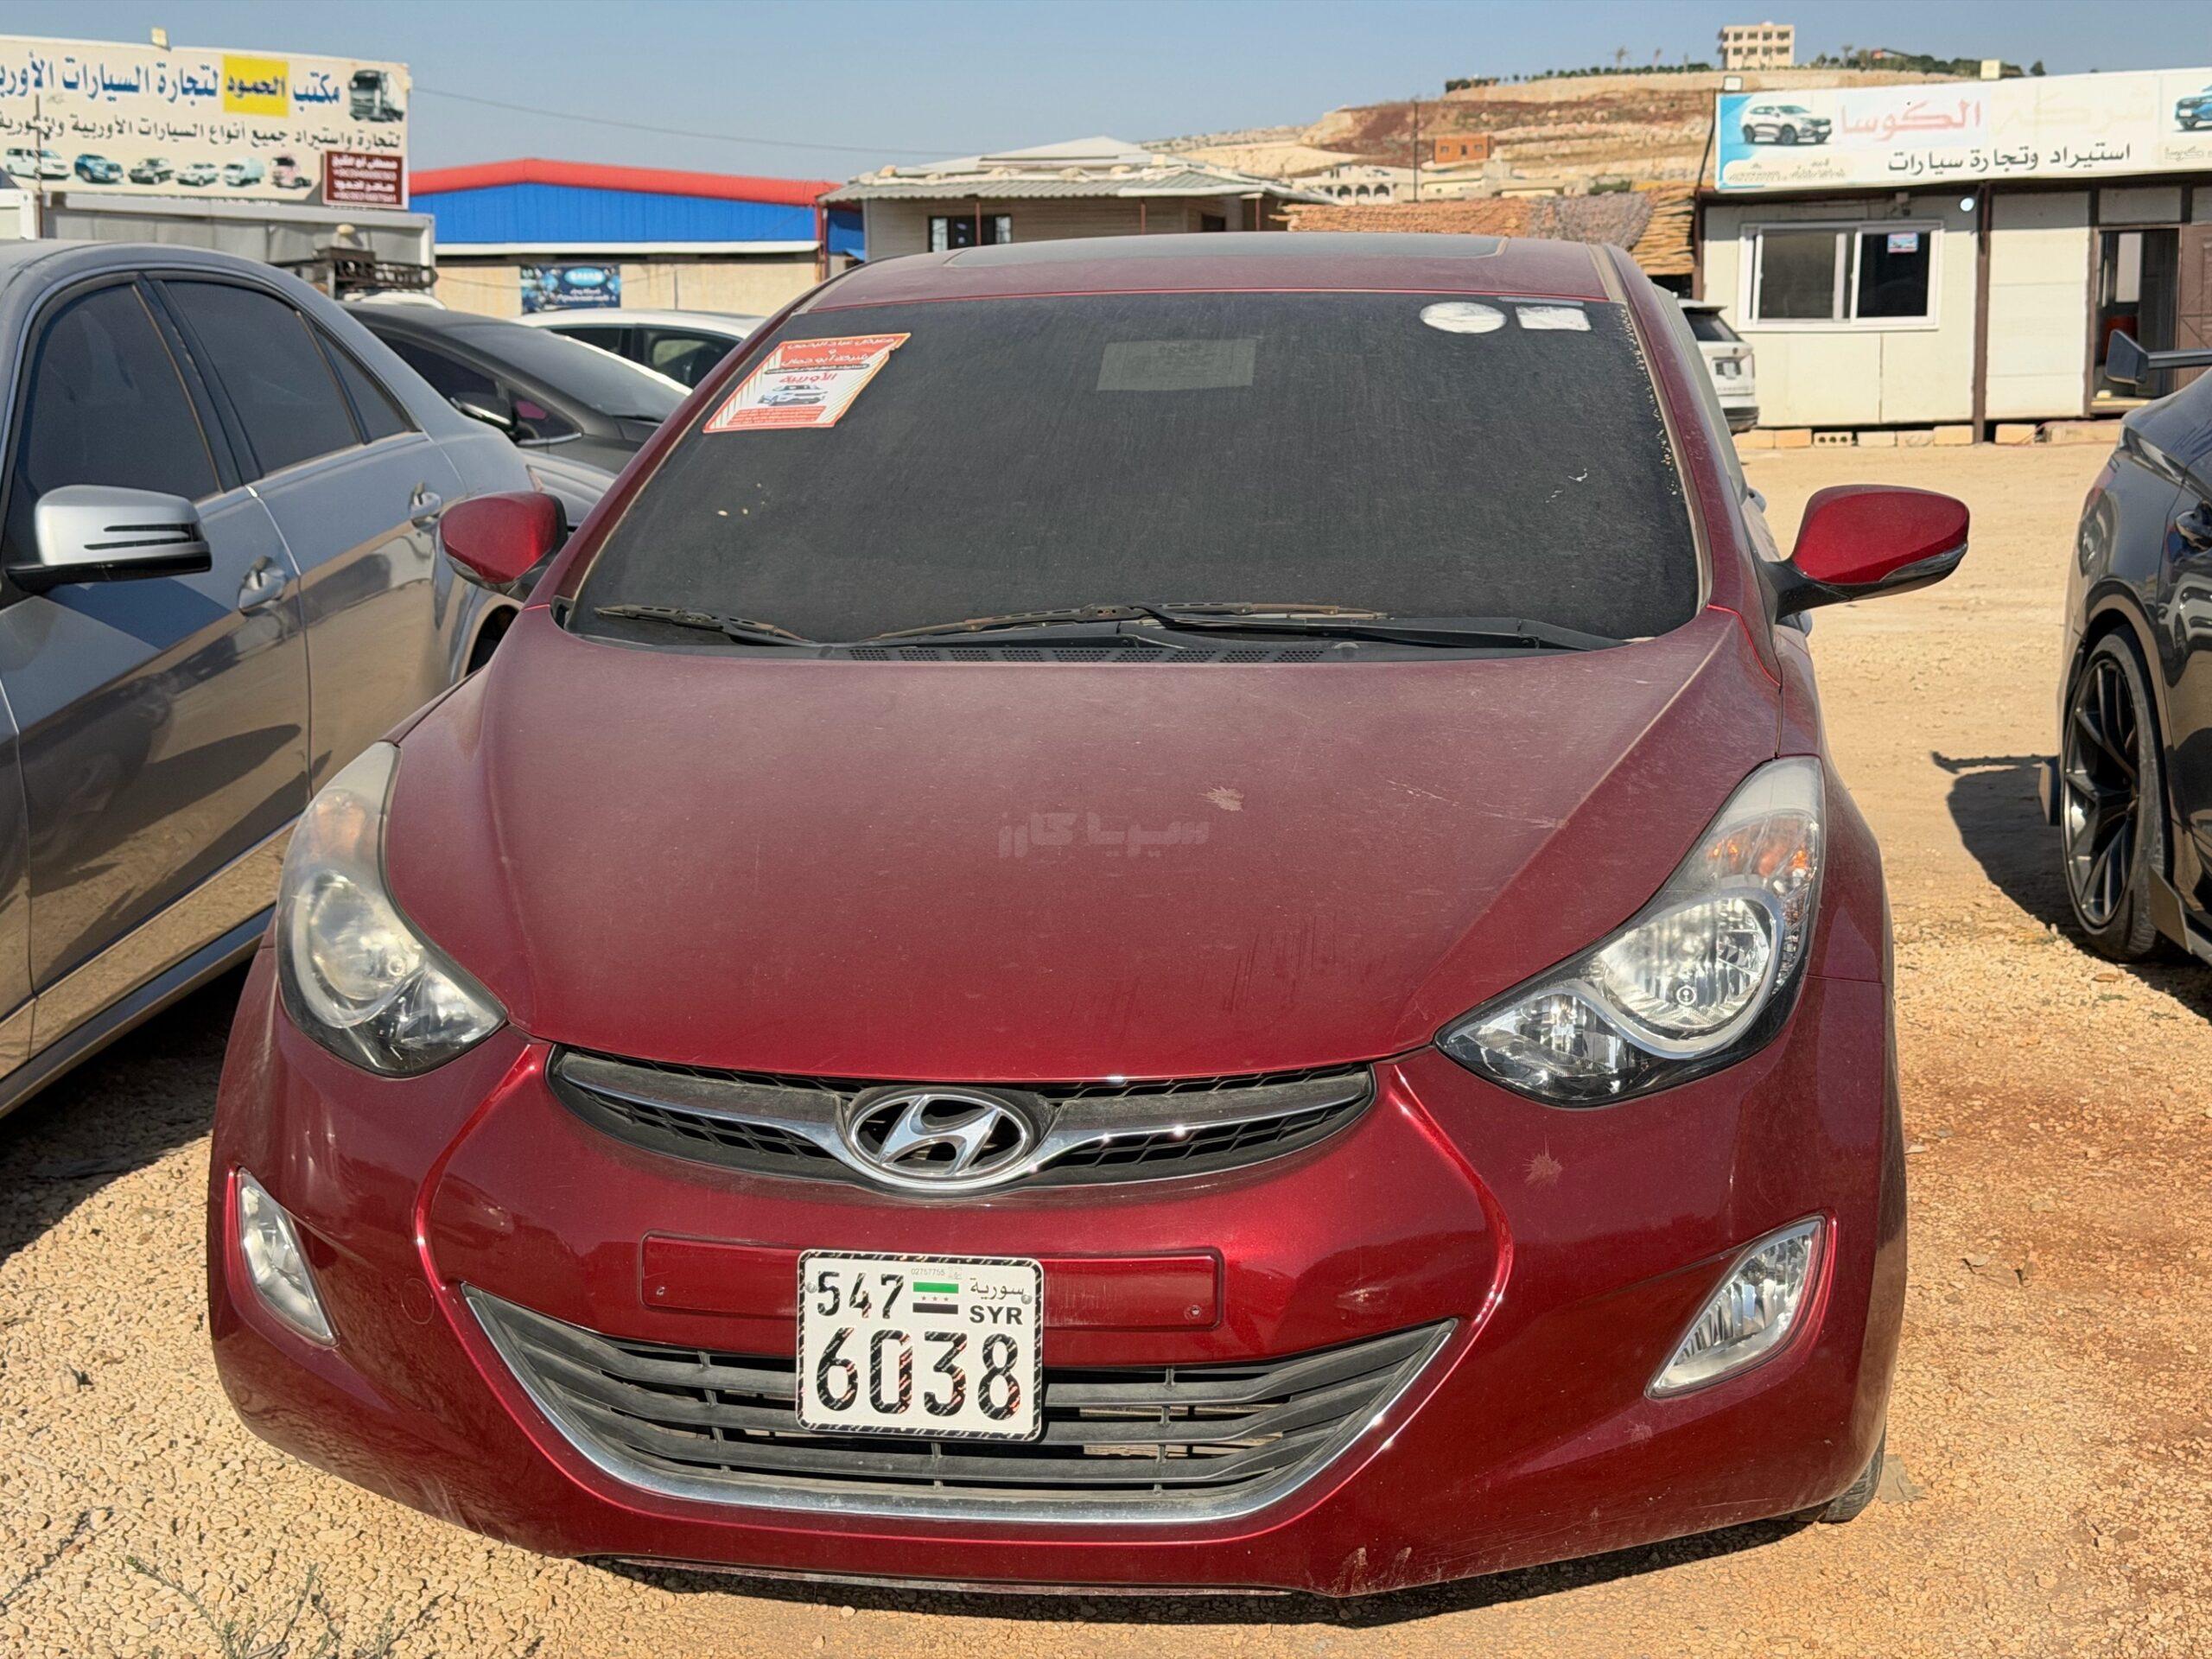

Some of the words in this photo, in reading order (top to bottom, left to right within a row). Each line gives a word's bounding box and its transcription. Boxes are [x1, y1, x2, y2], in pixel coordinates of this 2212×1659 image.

[62, 56, 149, 102] السيارات
[156, 61, 219, 106] لتجارة
[226, 75, 286, 99] الحمود
[293, 72, 340, 111] مكتب
[70, 114, 132, 140] الأوربية
[138, 118, 204, 142] السيارات
[1840, 97, 1981, 142] الكوسا
[209, 121, 245, 144] أنواع
[251, 129, 288, 147] جميع
[295, 127, 353, 150] واستيراد
[358, 129, 401, 154] لتجارة
[1888, 151, 1964, 175] سيارات
[1969, 146, 2039, 172] وتجارة
[2049, 143, 2131, 168] استيراد
[817, 1270, 905, 1319] 547
[969, 1277, 1025, 1300] سورية
[969, 1305, 1024, 1325] SYR
[816, 1326, 1021, 1421] 6038
